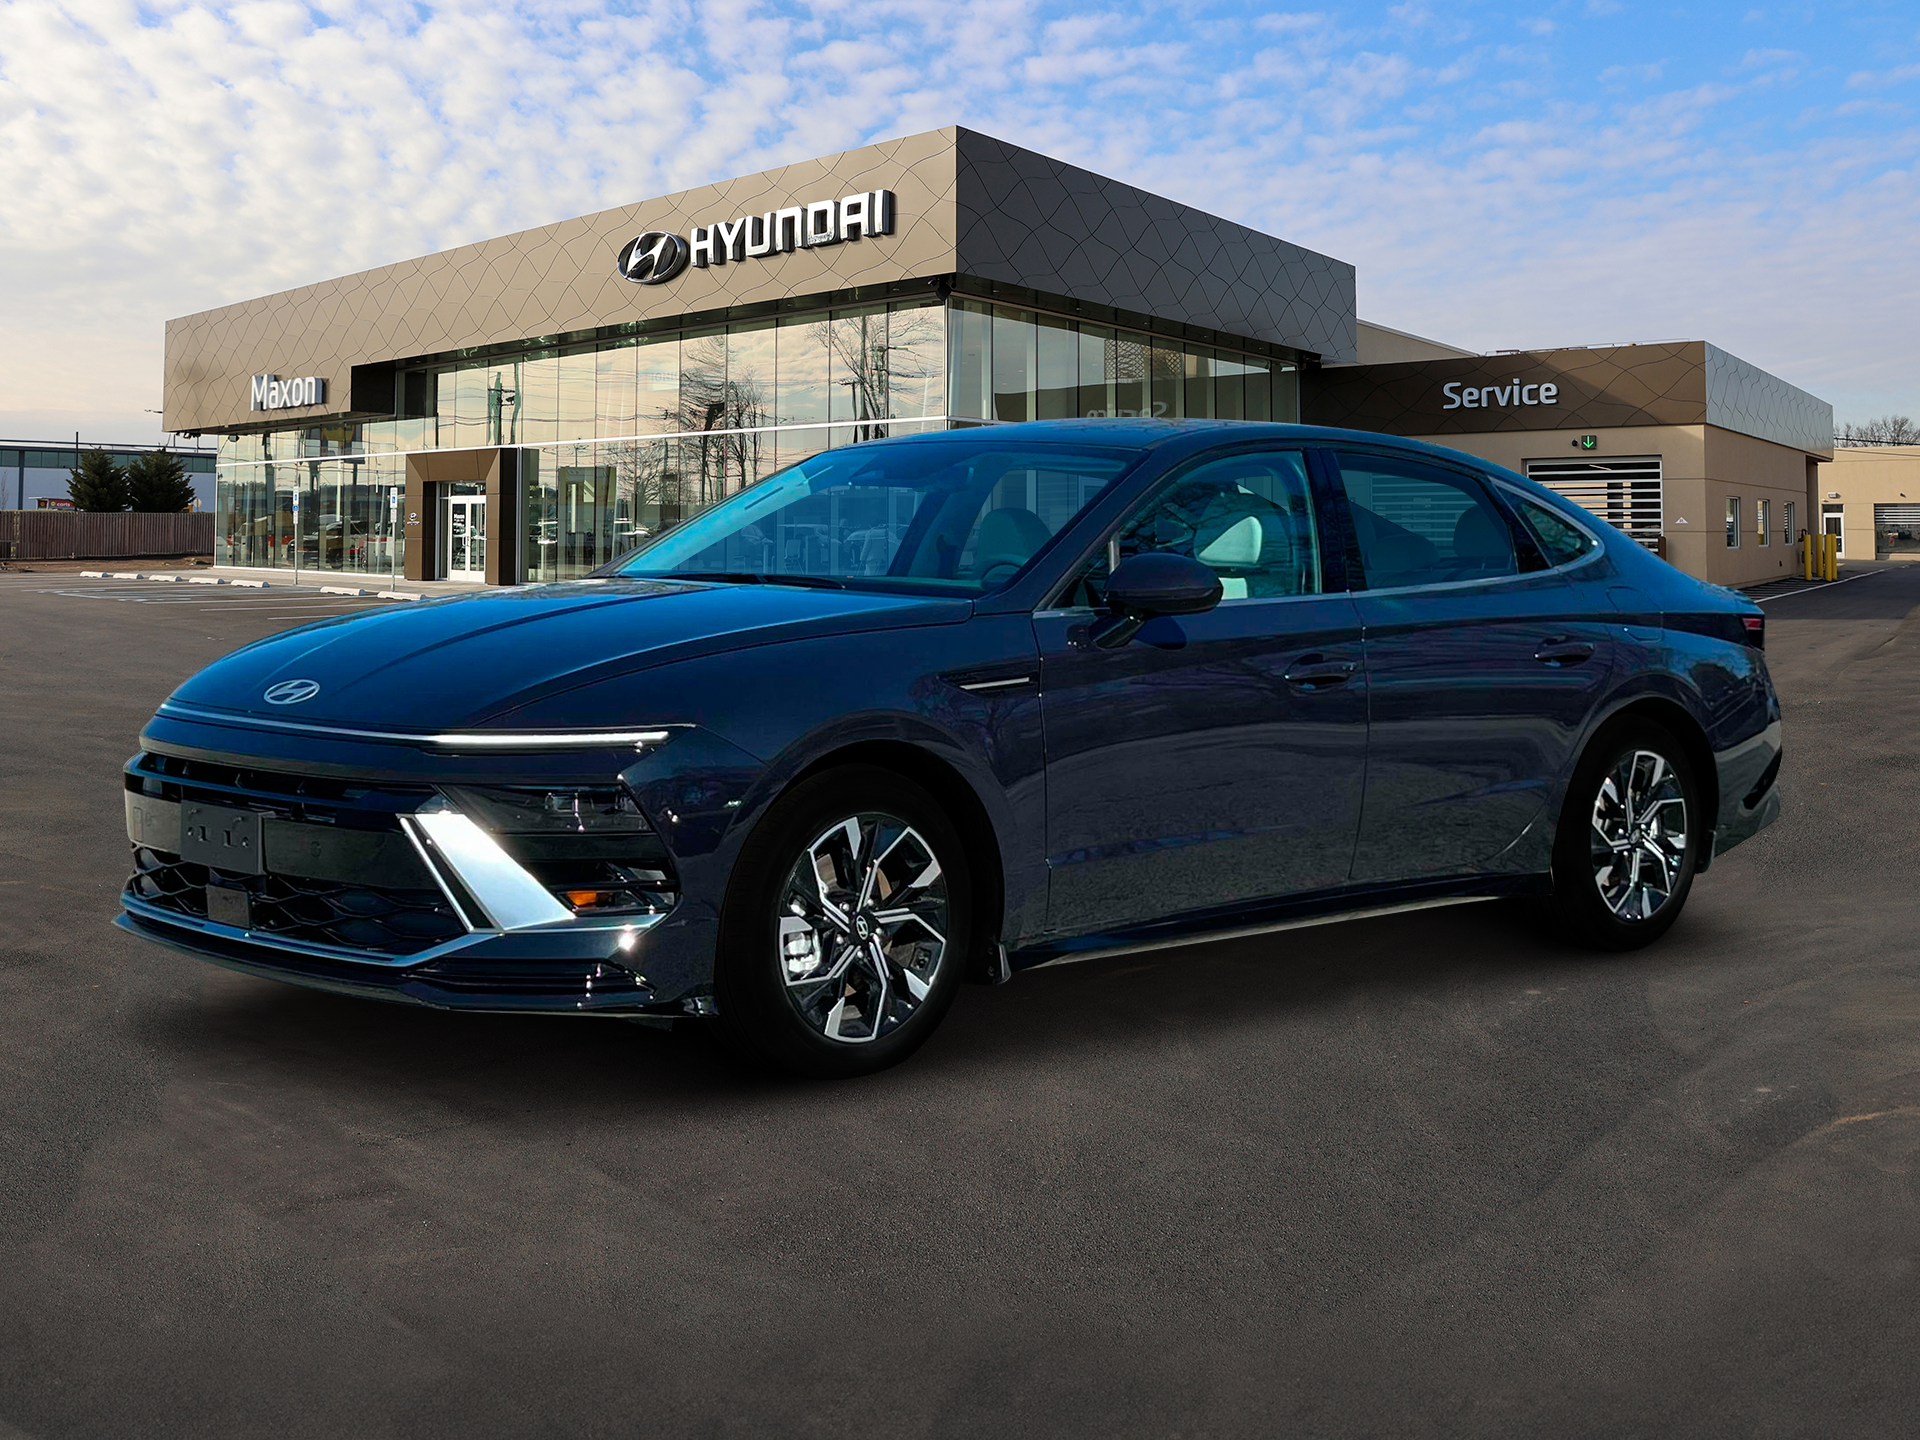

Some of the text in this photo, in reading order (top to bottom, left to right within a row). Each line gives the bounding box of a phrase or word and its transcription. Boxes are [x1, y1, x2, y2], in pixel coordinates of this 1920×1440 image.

[689, 189, 888, 267] HYUNDAI
[250, 374, 320, 411] Maxon
[1443, 378, 1558, 409] Service
